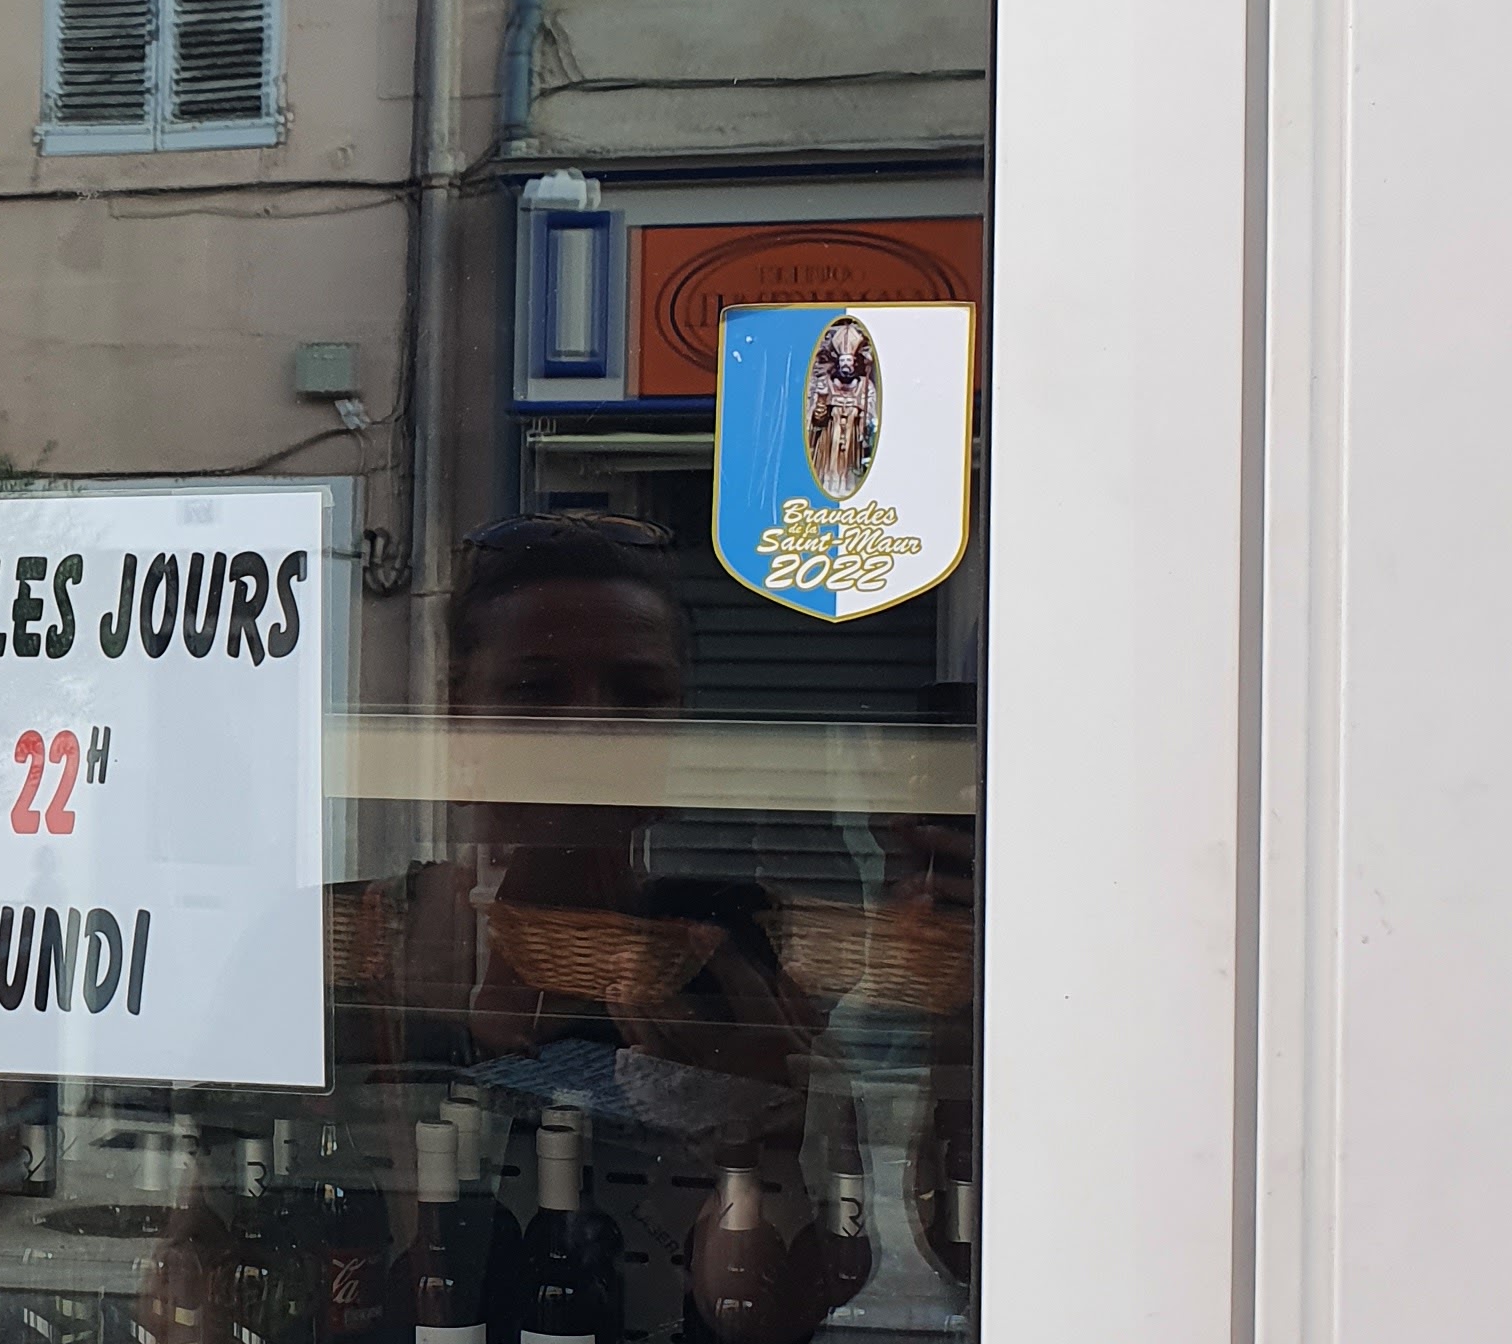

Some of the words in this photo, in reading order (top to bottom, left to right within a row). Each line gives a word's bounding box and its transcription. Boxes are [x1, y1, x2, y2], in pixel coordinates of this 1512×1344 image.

[782, 497, 898, 526] Bravades
[755, 525, 922, 555] Saint-Maur
[787, 523, 802, 535] de
[803, 523, 819, 537] la
[763, 553, 895, 592] 2022
[99, 550, 308, 667] JOURS
